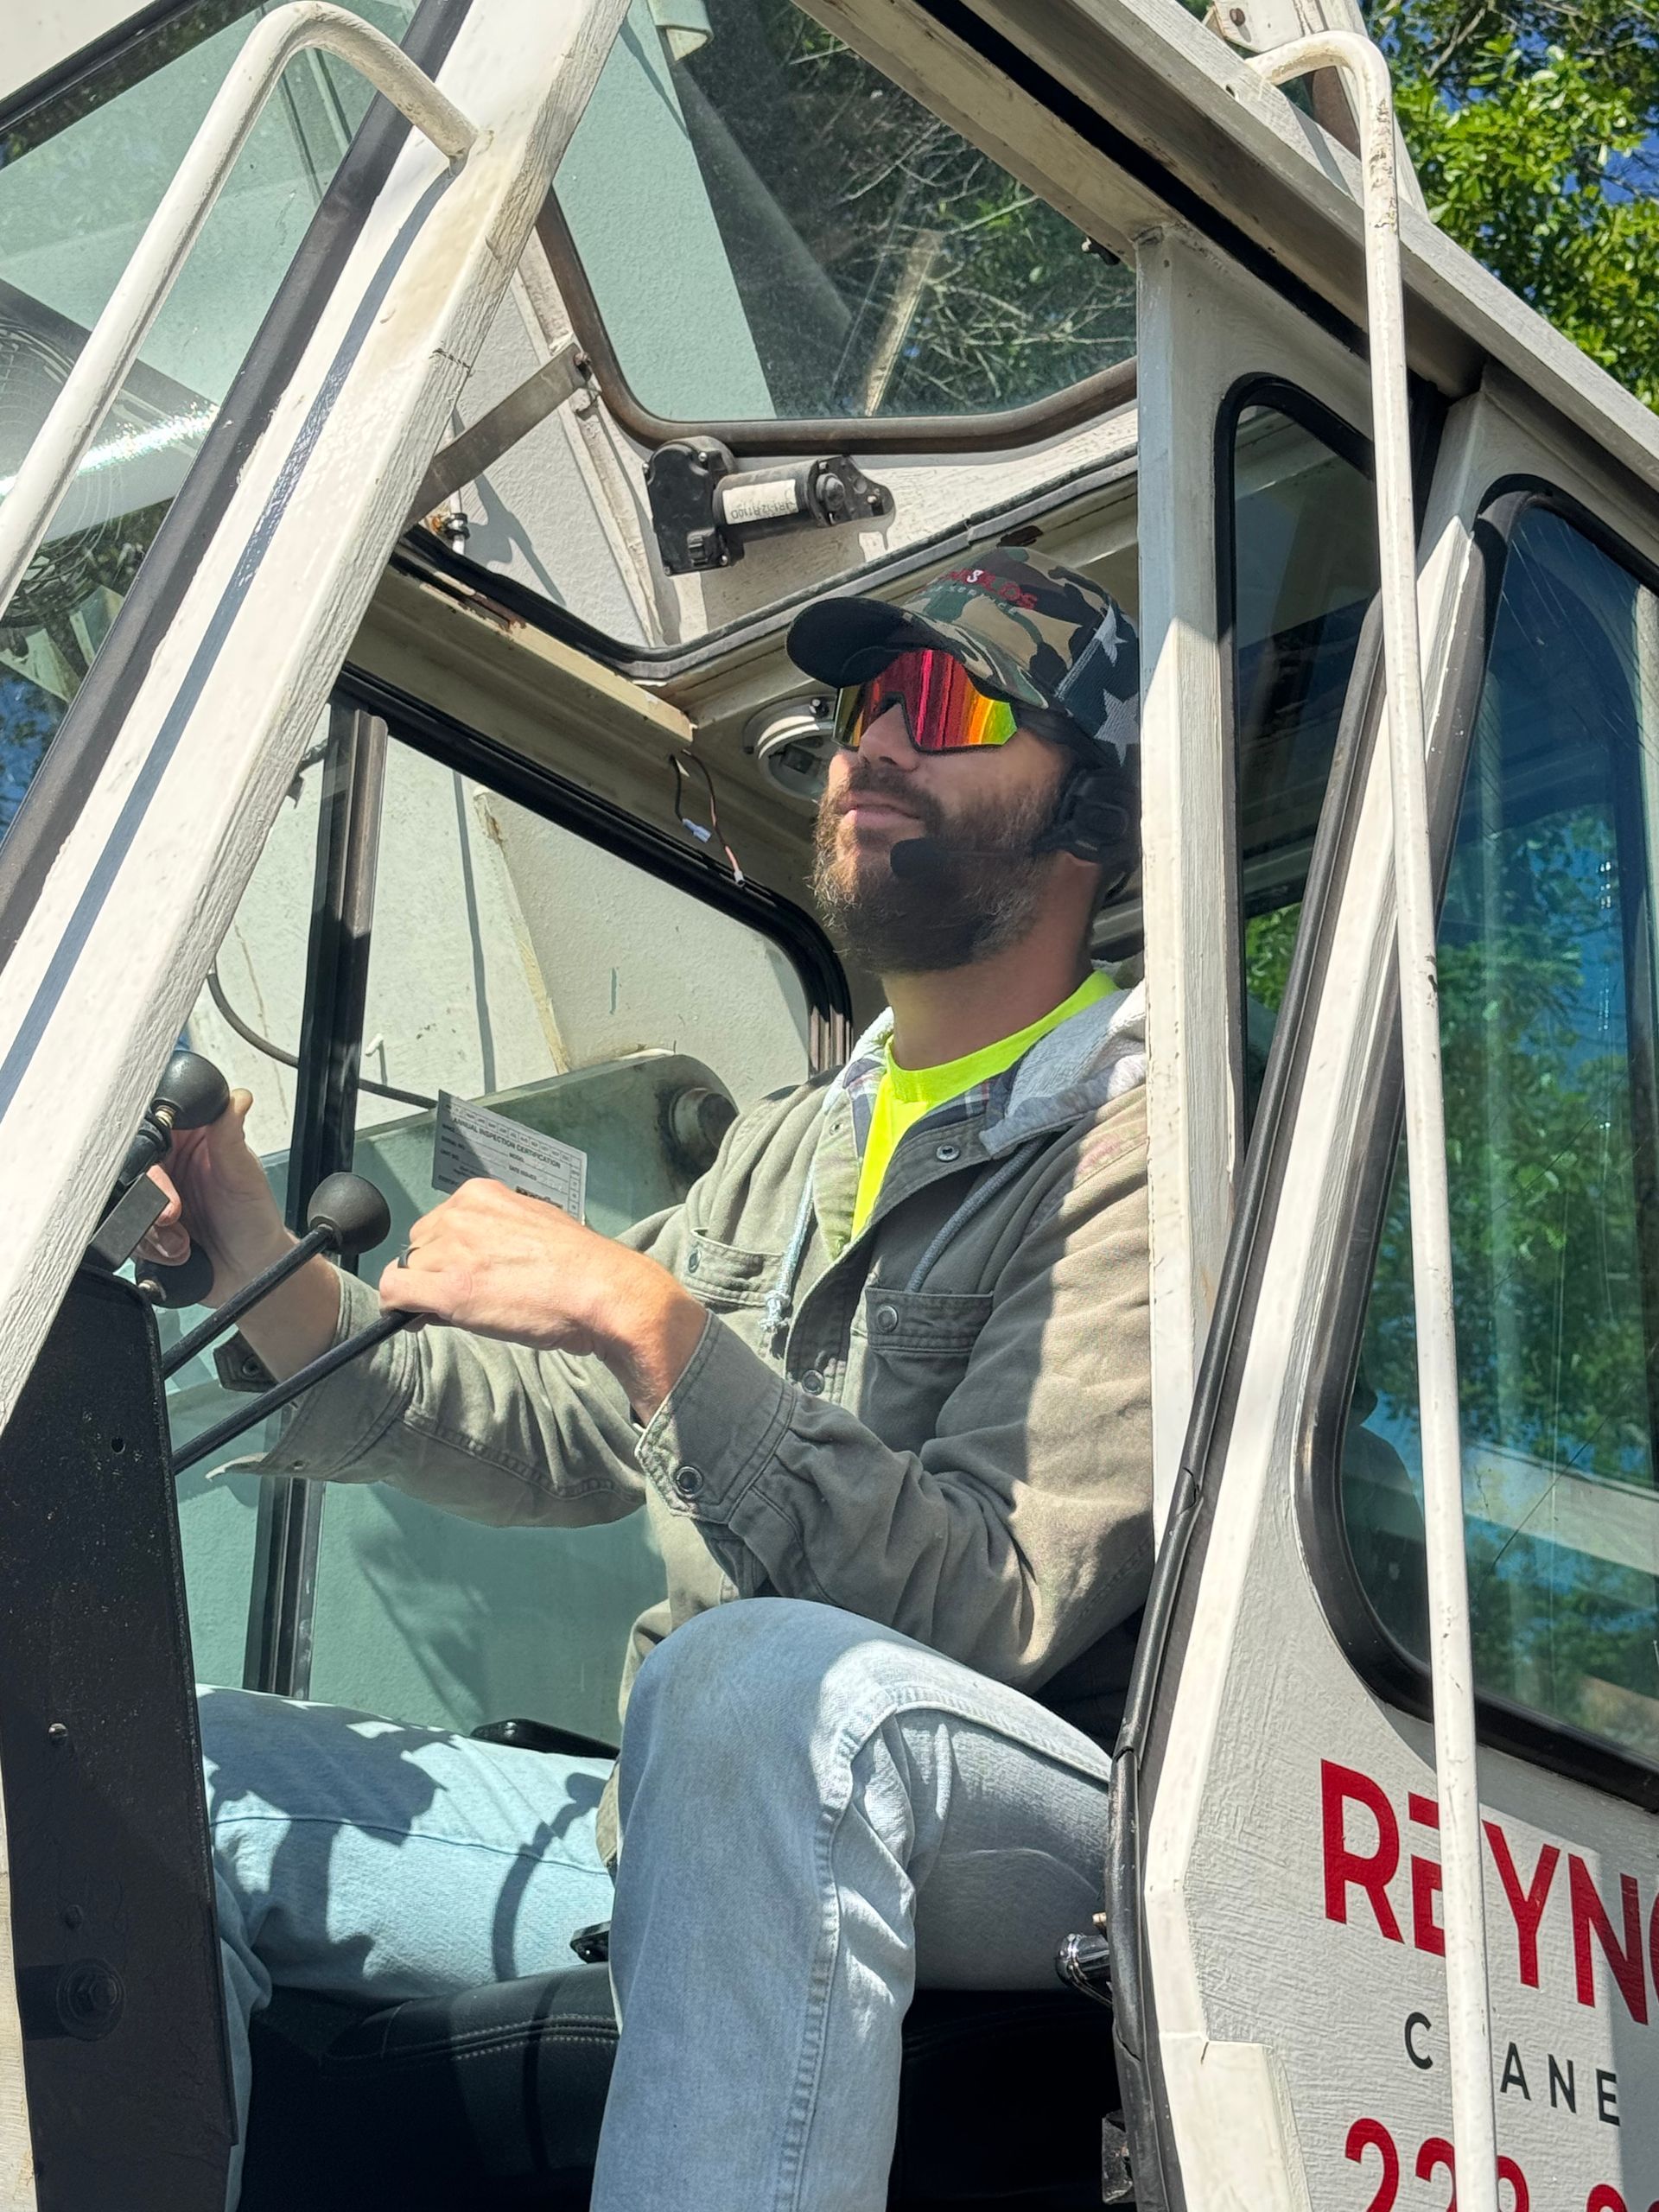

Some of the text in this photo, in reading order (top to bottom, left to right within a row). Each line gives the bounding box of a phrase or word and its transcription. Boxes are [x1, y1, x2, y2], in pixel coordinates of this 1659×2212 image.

[479, 1128, 515, 1149] INSPECTION
[516, 1143, 562, 1169] CERTIFICATION
[1320, 1758, 1659, 2026] REYN
[1403, 2012, 1621, 2126] CANE
